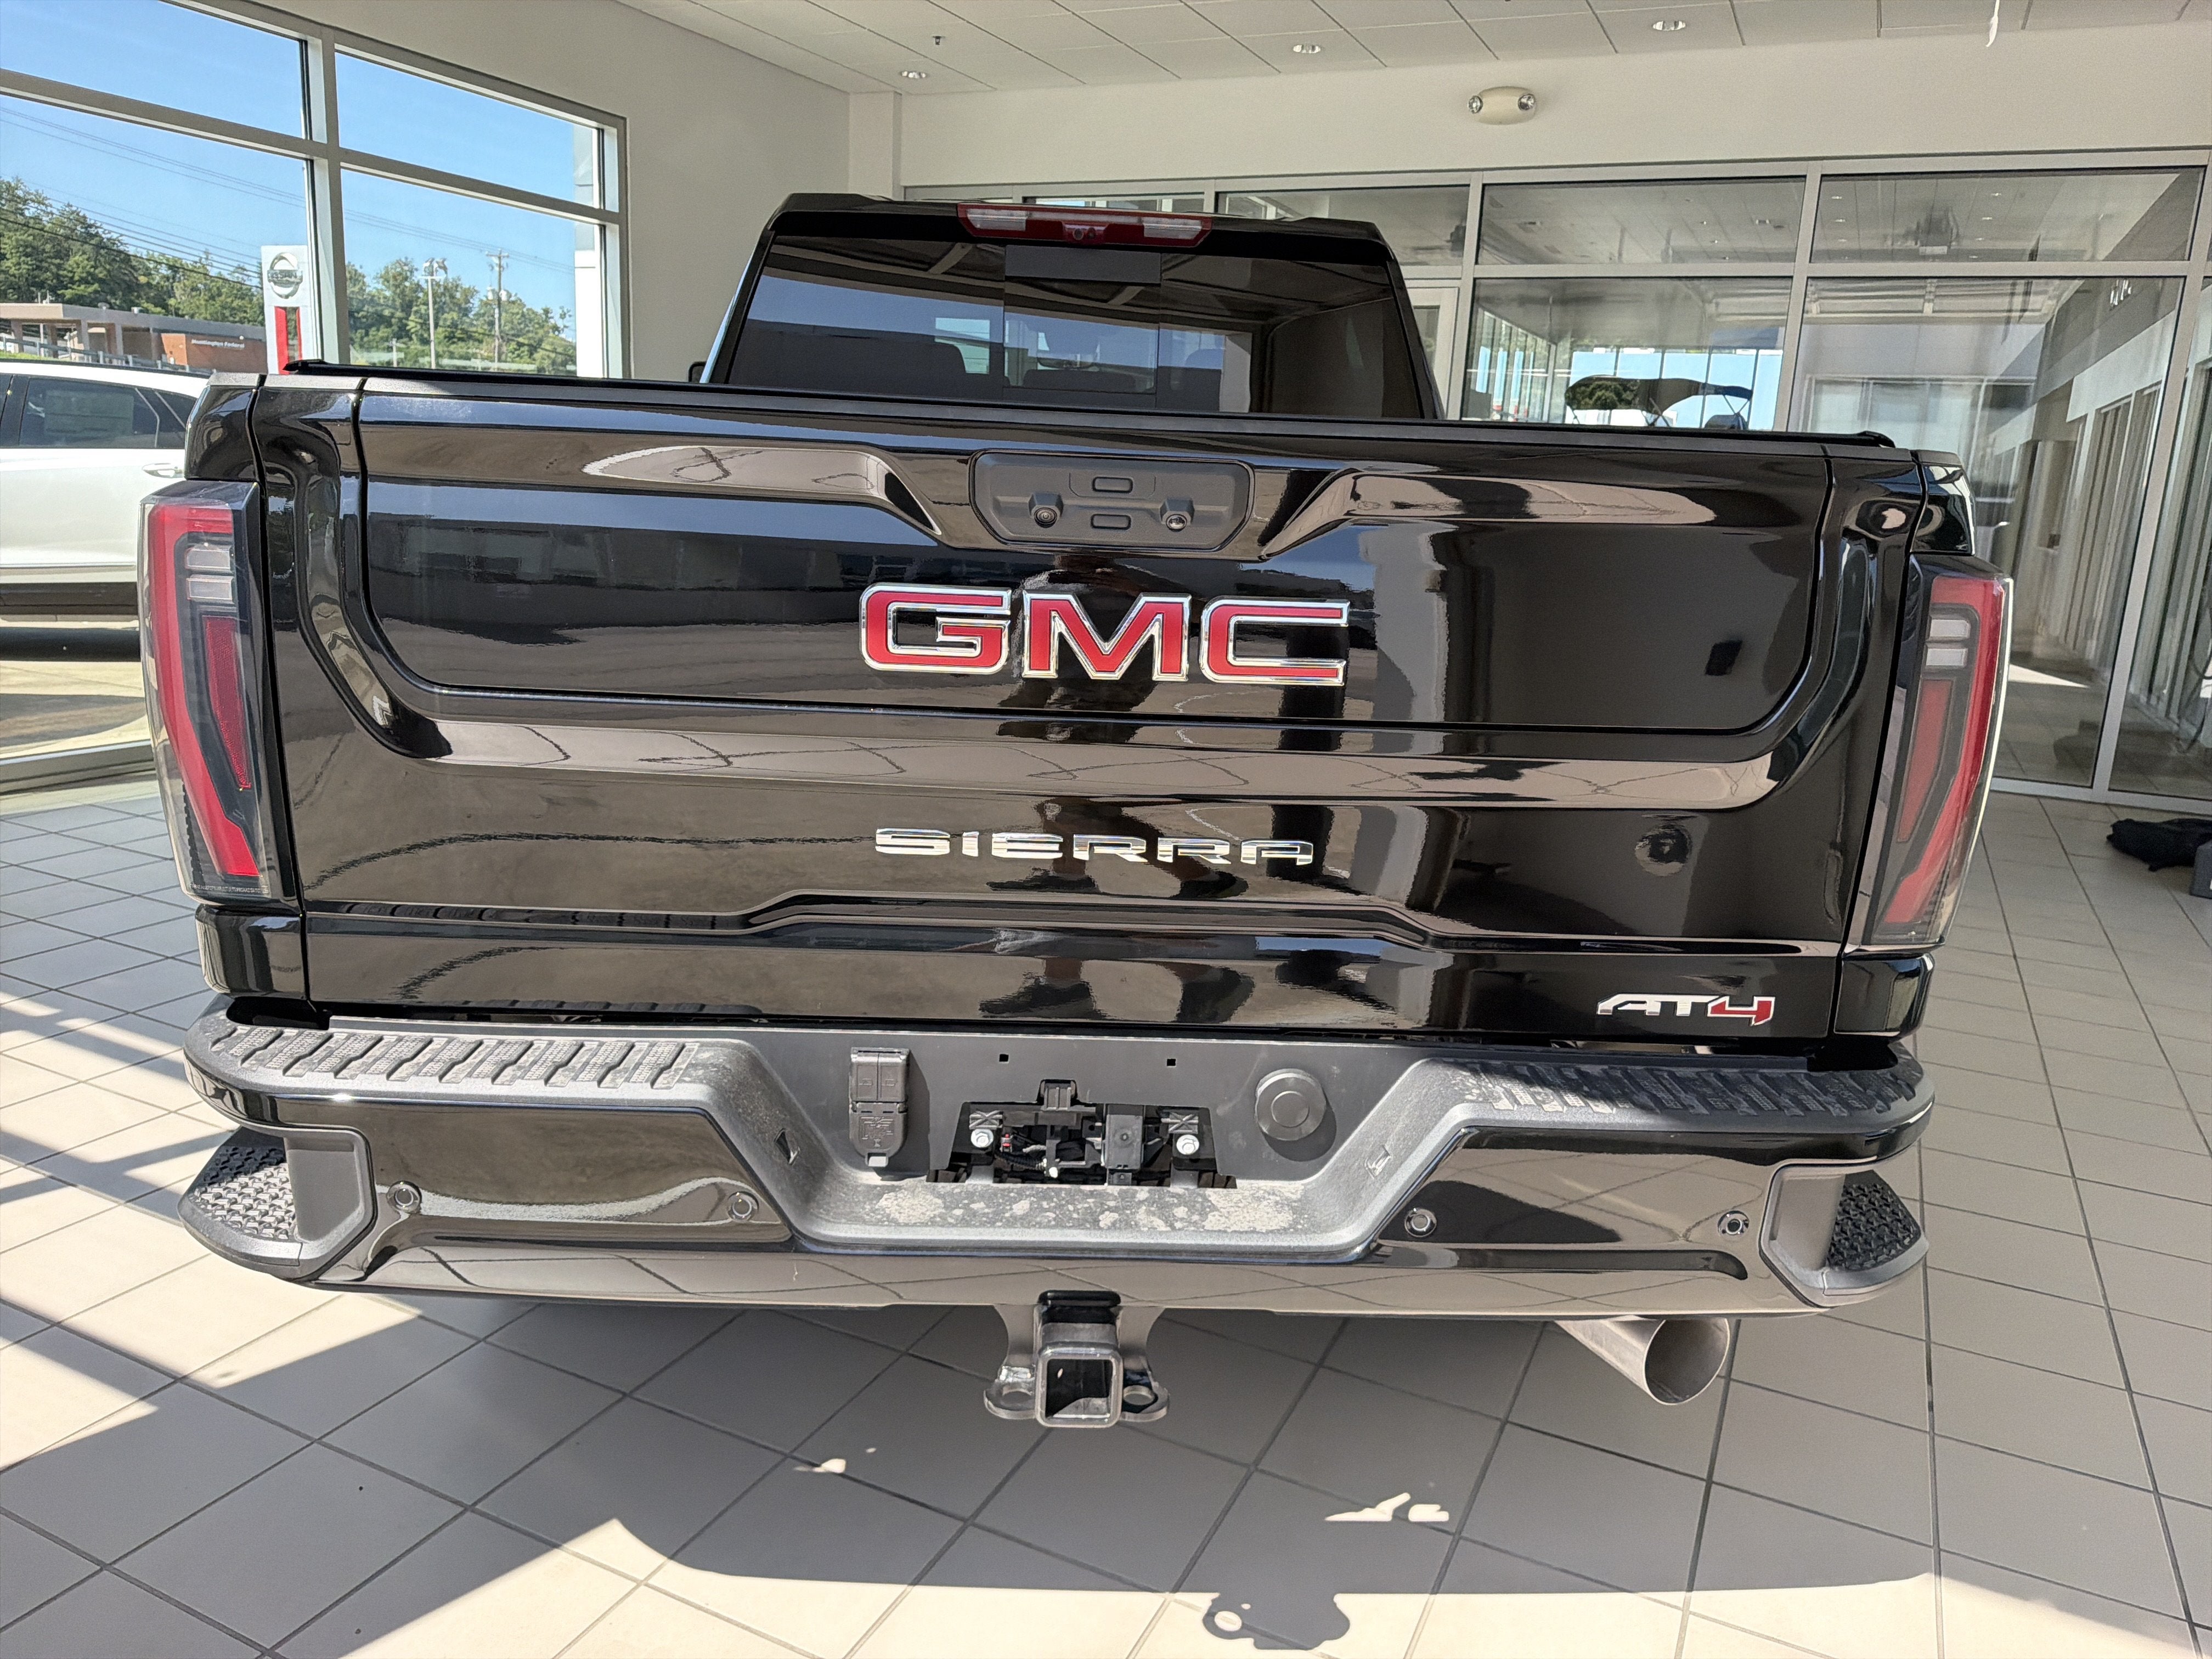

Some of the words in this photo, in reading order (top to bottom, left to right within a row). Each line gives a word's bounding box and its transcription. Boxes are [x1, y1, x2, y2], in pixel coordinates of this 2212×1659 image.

[859, 582, 1350, 686] GMC
[874, 827, 1314, 866] SIERRA
[1597, 993, 1776, 1026] AT4
